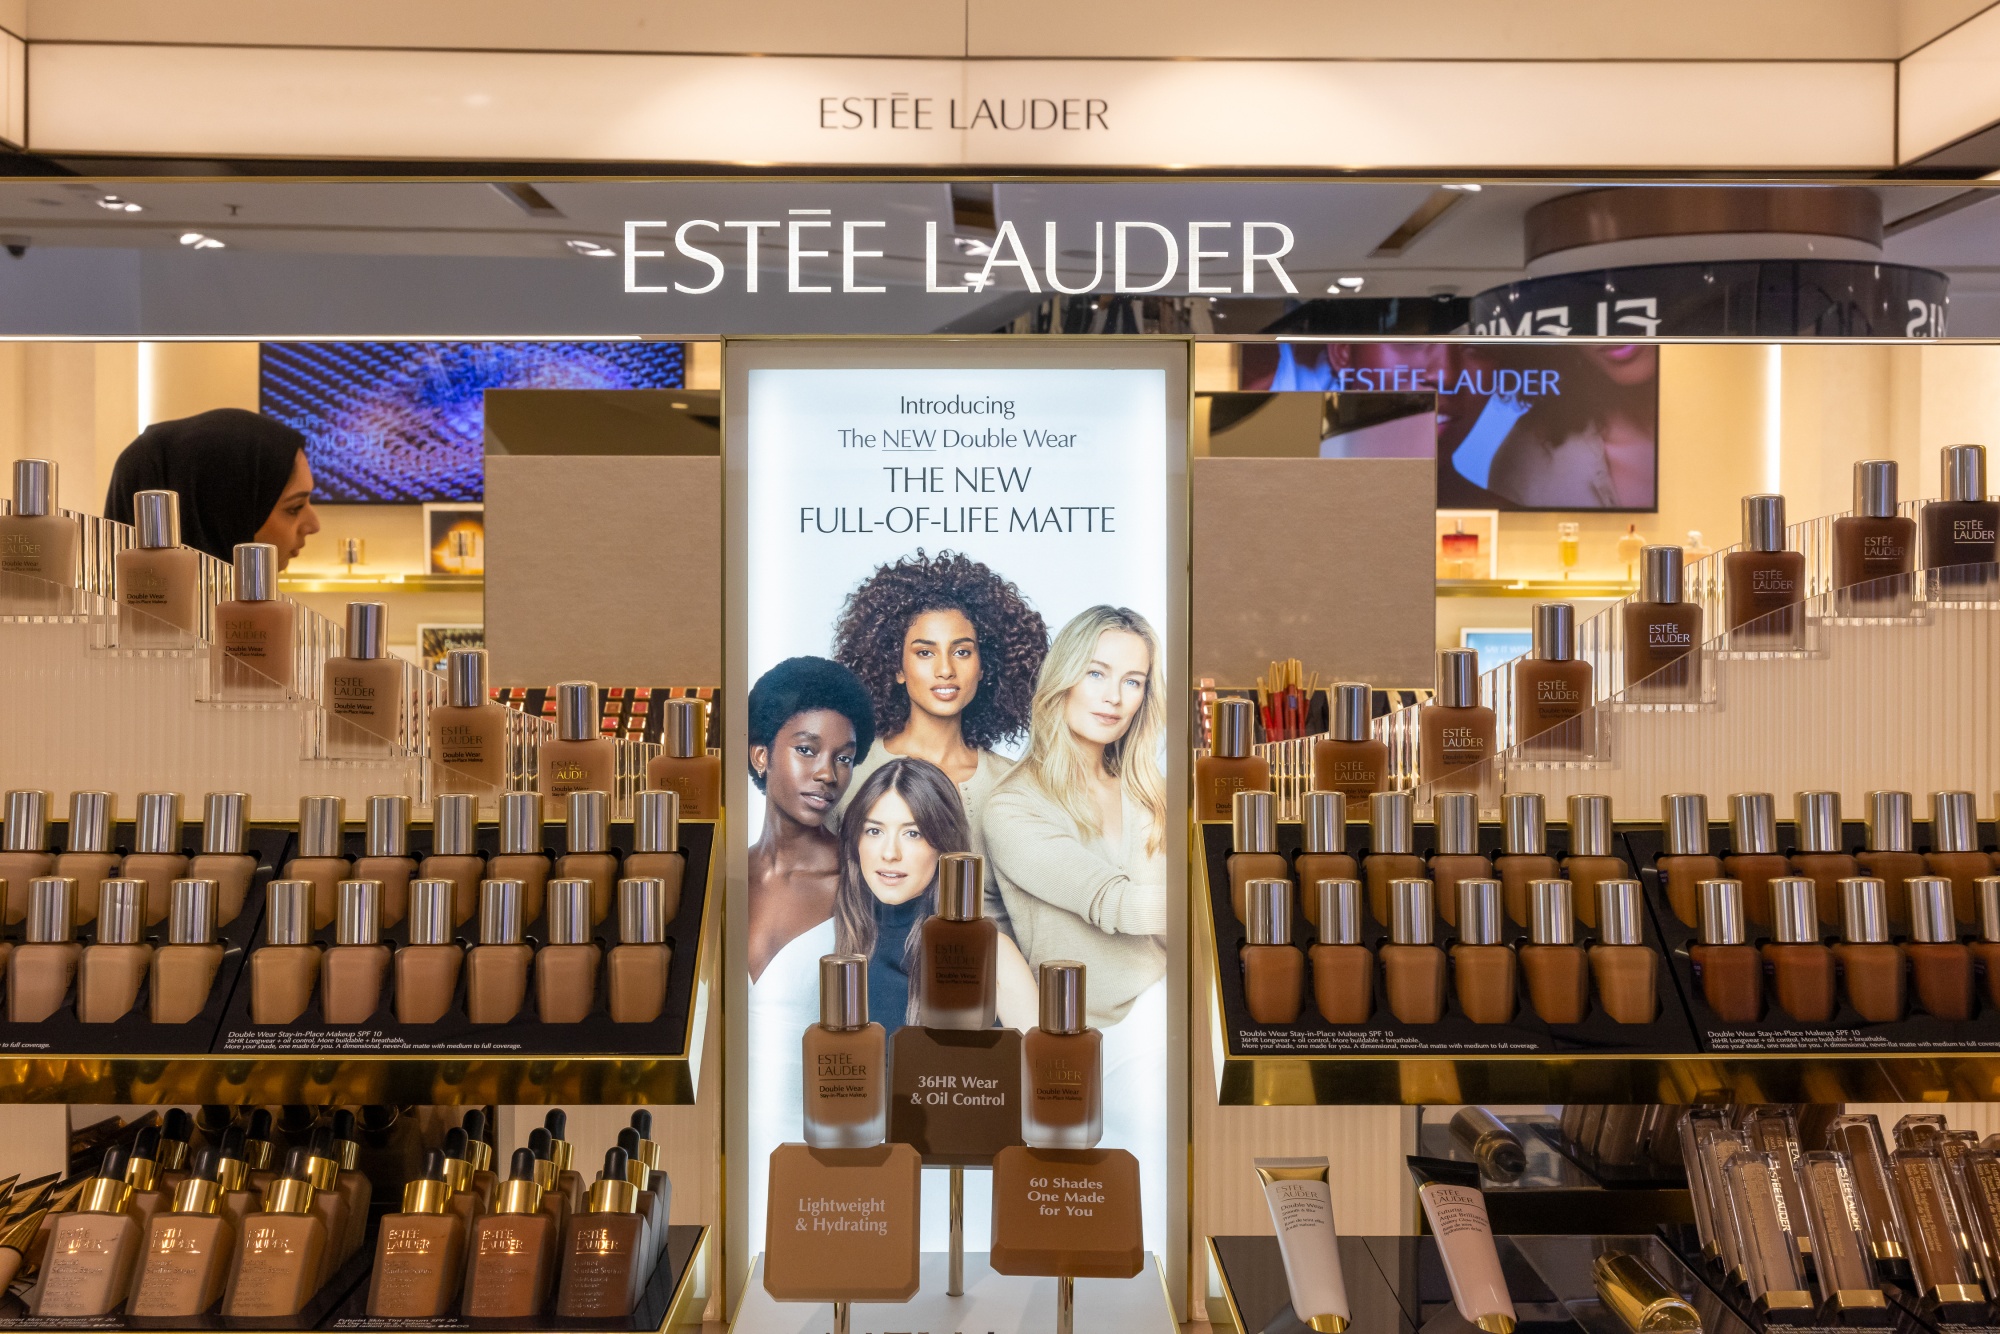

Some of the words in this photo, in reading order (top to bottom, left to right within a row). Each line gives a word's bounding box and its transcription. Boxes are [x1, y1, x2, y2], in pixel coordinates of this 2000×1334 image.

[950, 98, 1110, 131] LAUDER
[926, 219, 1298, 294] LAUDER
[1439, 369, 1560, 395] LAUDER
[900, 394, 1015, 420] Introducing
[838, 429, 876, 448] The
[882, 429, 937, 448] NEW
[943, 428, 1017, 448] Double
[1023, 429, 1076, 448] Wear
[883, 466, 944, 493] THE
[955, 466, 1032, 493] NEW
[800, 507, 999, 534] FULL-OF-LIFE
[1009, 507, 1115, 533] MATTE
[1954, 530, 1994, 540] LAUDER
[1864, 546, 1904, 556] LAUDER
[1753, 580, 1794, 590] LAUDER
[1650, 634, 1690, 643] LAUDER
[334, 687, 375, 696] LAUDER
[1538, 691, 1579, 700] LAUDER
[441, 736, 482, 745] LAUDER
[1442, 738, 1483, 747] LAUDER
[1334, 771, 1375, 781] LAUDER
[278, 1031, 325, 1039] Stay-in-Place
[1290, 1030, 1336, 1038] Stay-in-Place
[1338, 1030, 1367, 1038] Makeup
[818, 1065, 866, 1076] LAUDER
[918, 1076, 956, 1088] 36HR
[961, 1077, 998, 1089] Wear
[910, 1093, 922, 1106] &
[926, 1092, 948, 1105] Oil
[952, 1092, 1004, 1106] Control
[1918, 1163, 1932, 1189] Futurist
[1029, 1177, 1048, 1189] 60
[1053, 1177, 1103, 1190] Shades
[1027, 1191, 1059, 1203] One
[1064, 1192, 1105, 1204] Made
[1434, 1196, 1474, 1205] LAUDER
[798, 1197, 886, 1217] Lightweight
[1039, 1205, 1060, 1216] for
[1065, 1206, 1093, 1217] You
[1280, 1202, 1305, 1211] Double
[1847, 1195, 1862, 1231] LAUDER
[1776, 1195, 1791, 1232] LAUDER
[795, 1217, 807, 1232] &
[813, 1217, 887, 1236] Hydrating
